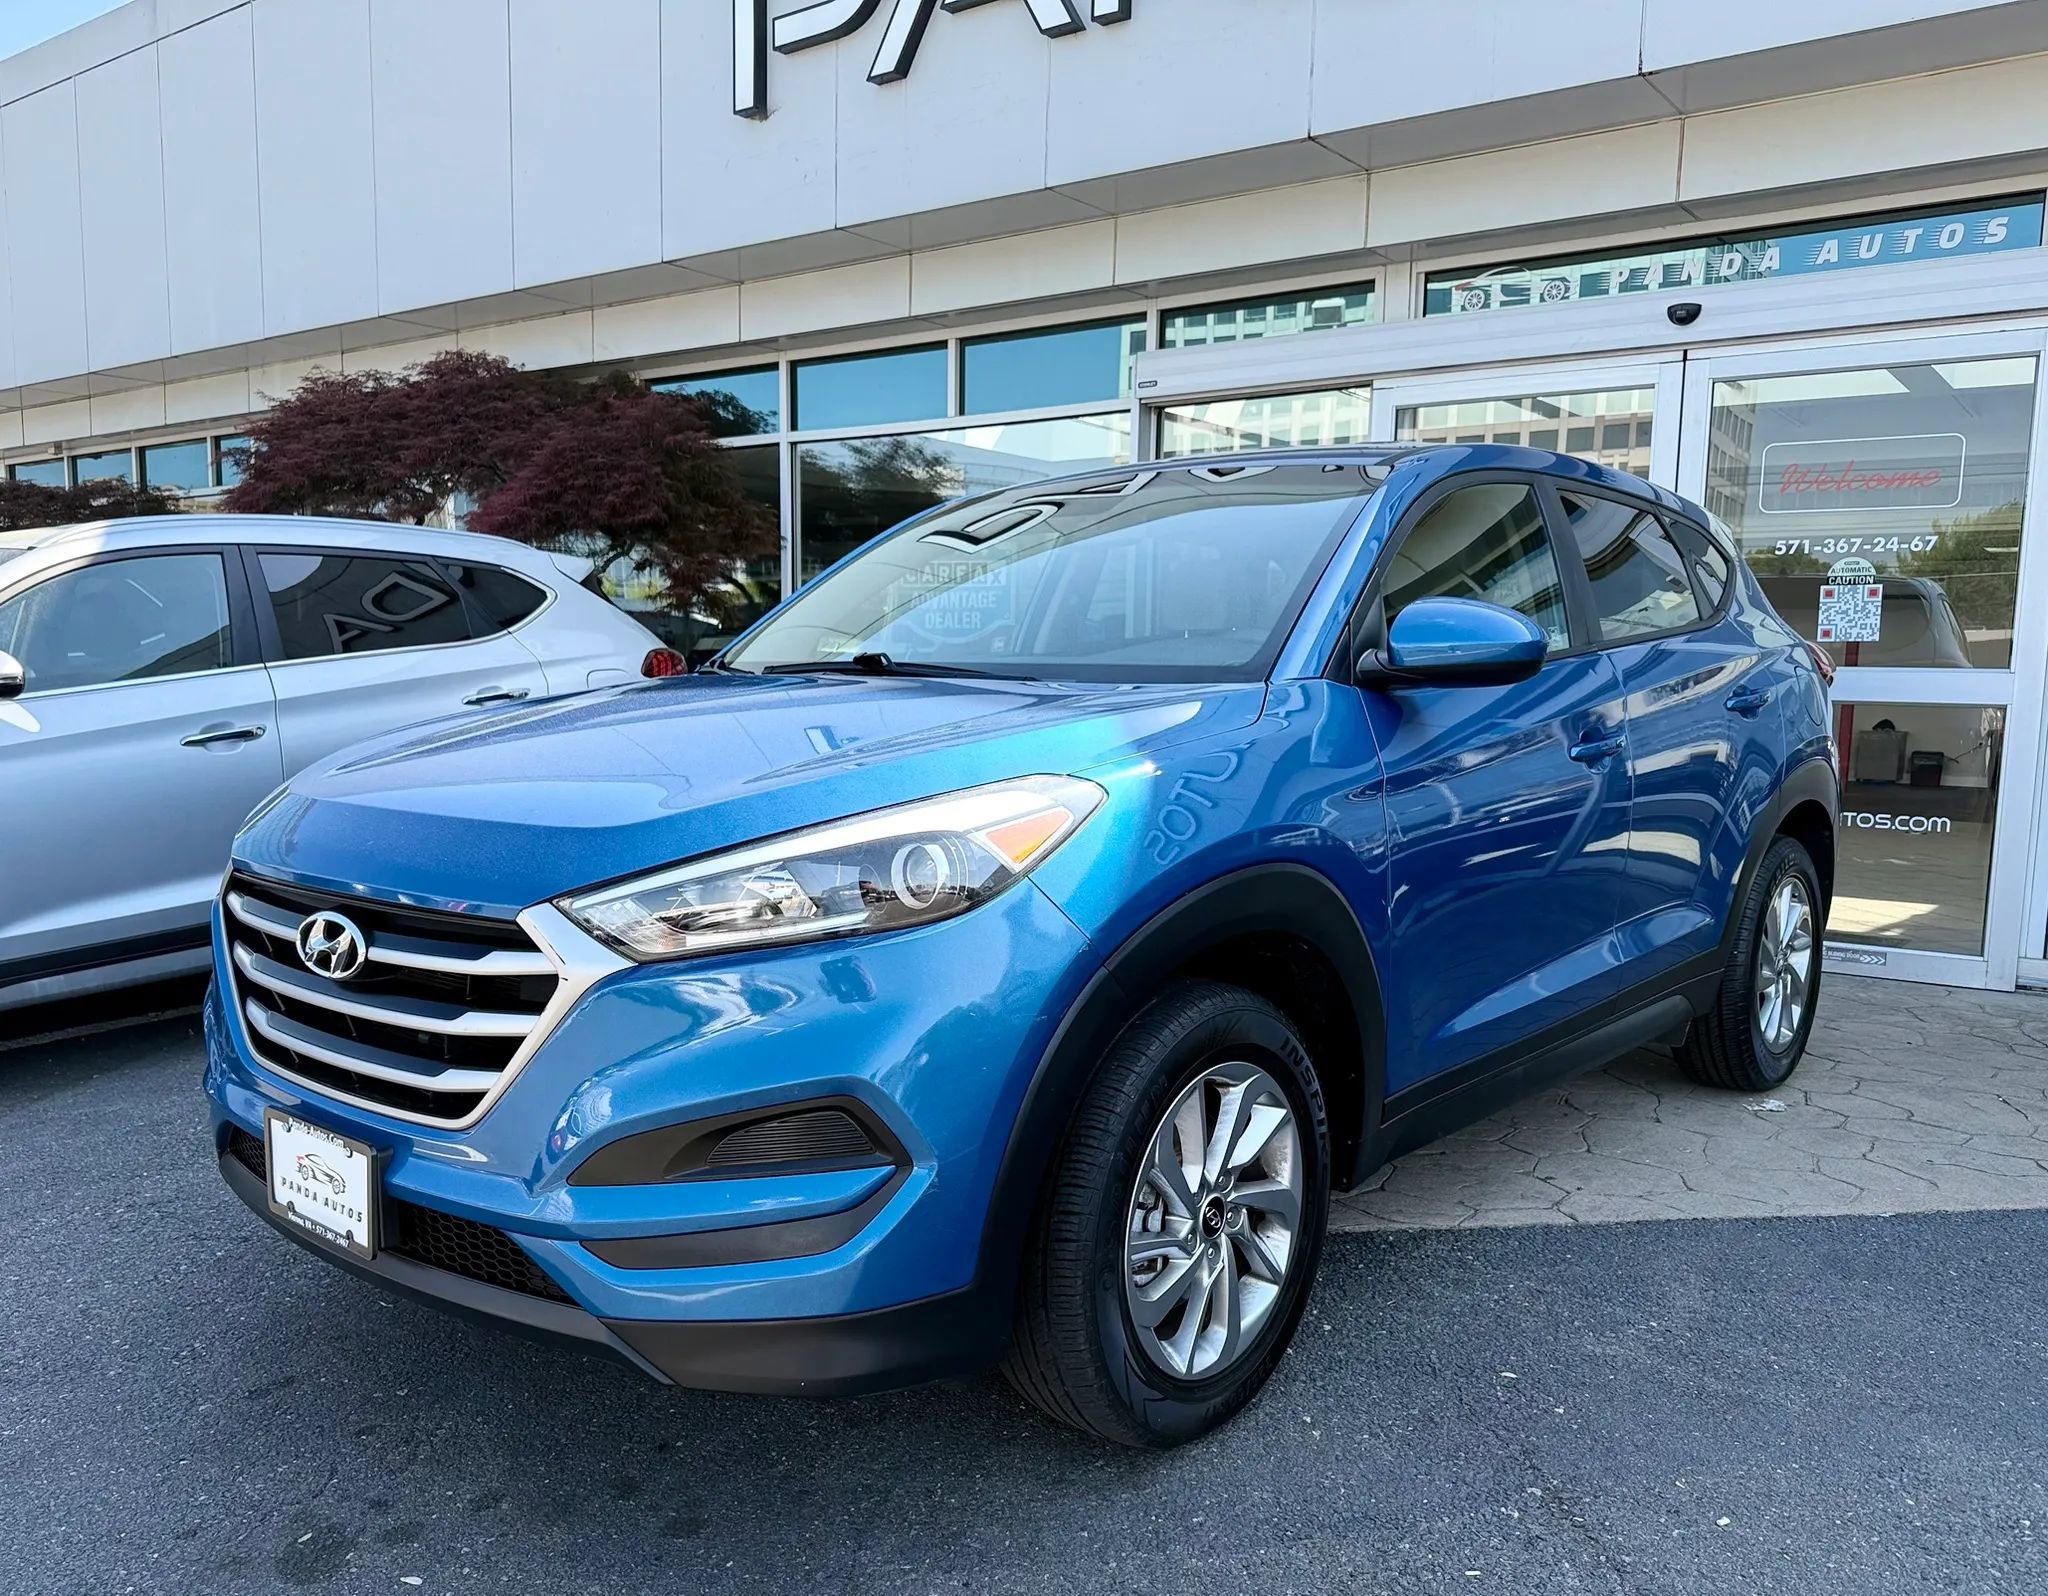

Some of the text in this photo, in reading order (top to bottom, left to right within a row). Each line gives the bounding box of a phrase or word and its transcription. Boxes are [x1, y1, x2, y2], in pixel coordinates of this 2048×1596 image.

[1606, 215, 2010, 289] PANDA AUTOS
[1780, 459, 1943, 496] Welcome
[1774, 535, 1939, 556] 571-367-24-67
[1828, 575, 1875, 585] CAUTION
[1830, 566, 1873, 575] AUTOMATIC
[924, 611, 981, 630] DEALER
[281, 1175, 363, 1223] PANDA AUTOS
